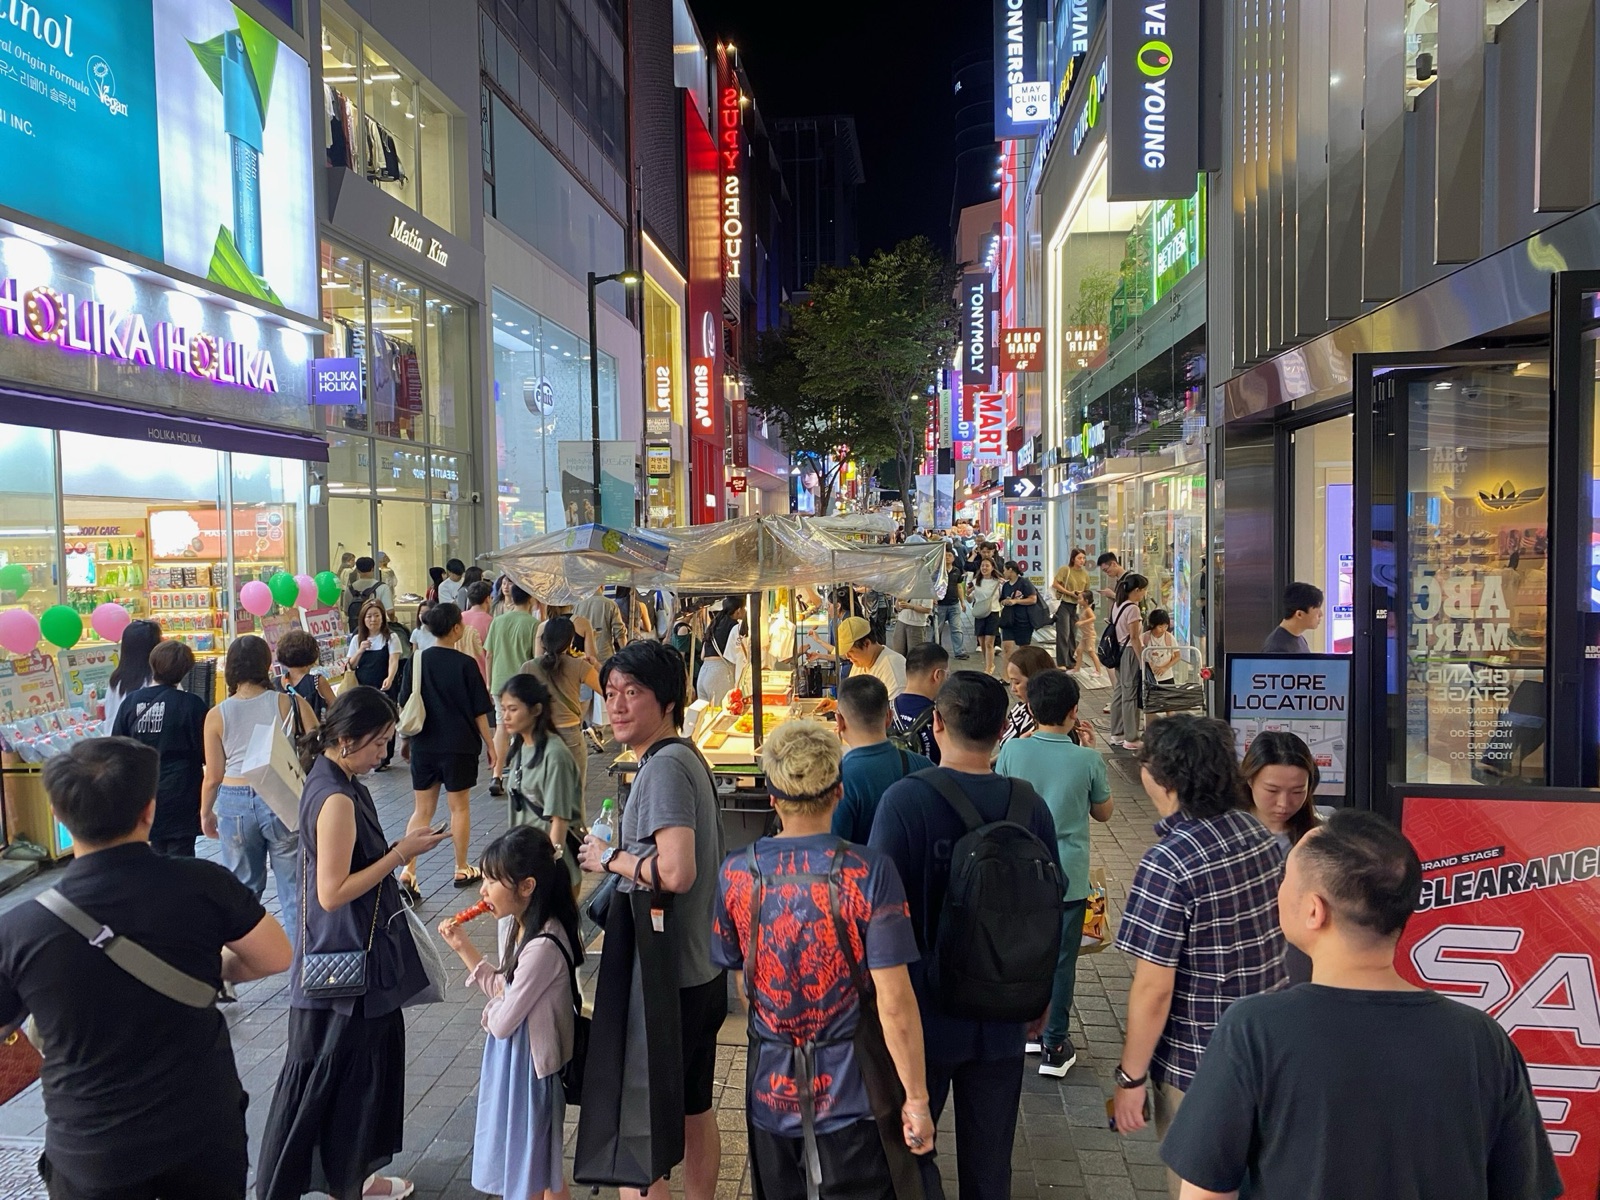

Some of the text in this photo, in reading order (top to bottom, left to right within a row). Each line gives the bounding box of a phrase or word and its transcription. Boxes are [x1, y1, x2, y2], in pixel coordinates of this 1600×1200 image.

[14, 45, 47, 73] Origin
[49, 63, 90, 96] Formula
[20, 70, 48, 97] 리페어
[49, 88, 76, 112] 솔루션
[1015, 94, 1047, 103] CLINIC
[10, 113, 36, 137] INC.
[1144, 79, 1166, 169] YOUNG
[1157, 203, 1176, 245] LIVE
[390, 216, 448, 267] Matin Kim
[1157, 227, 1188, 277] BETTER
[970, 283, 984, 375] TONYMOLY
[1005, 332, 1041, 343] JUNO
[158, 321, 279, 393] HOLIKA
[1008, 343, 1037, 353] HAIR
[319, 371, 357, 382] HOLIKA
[319, 382, 357, 392] HOLIKA
[148, 427, 203, 444] HOLIKA HOLIKA
[979, 395, 1002, 456] MART
[1432, 446, 1468, 461] ABC
[1432, 462, 1468, 473] MART
[100, 526, 121, 535] CARE
[1017, 513, 1029, 572] JUNO
[1031, 514, 1042, 571] HAIR
[1251, 674, 1326, 690] STORE
[1233, 694, 1345, 711] LOCATION
[1461, 848, 1500, 863] STAGE
